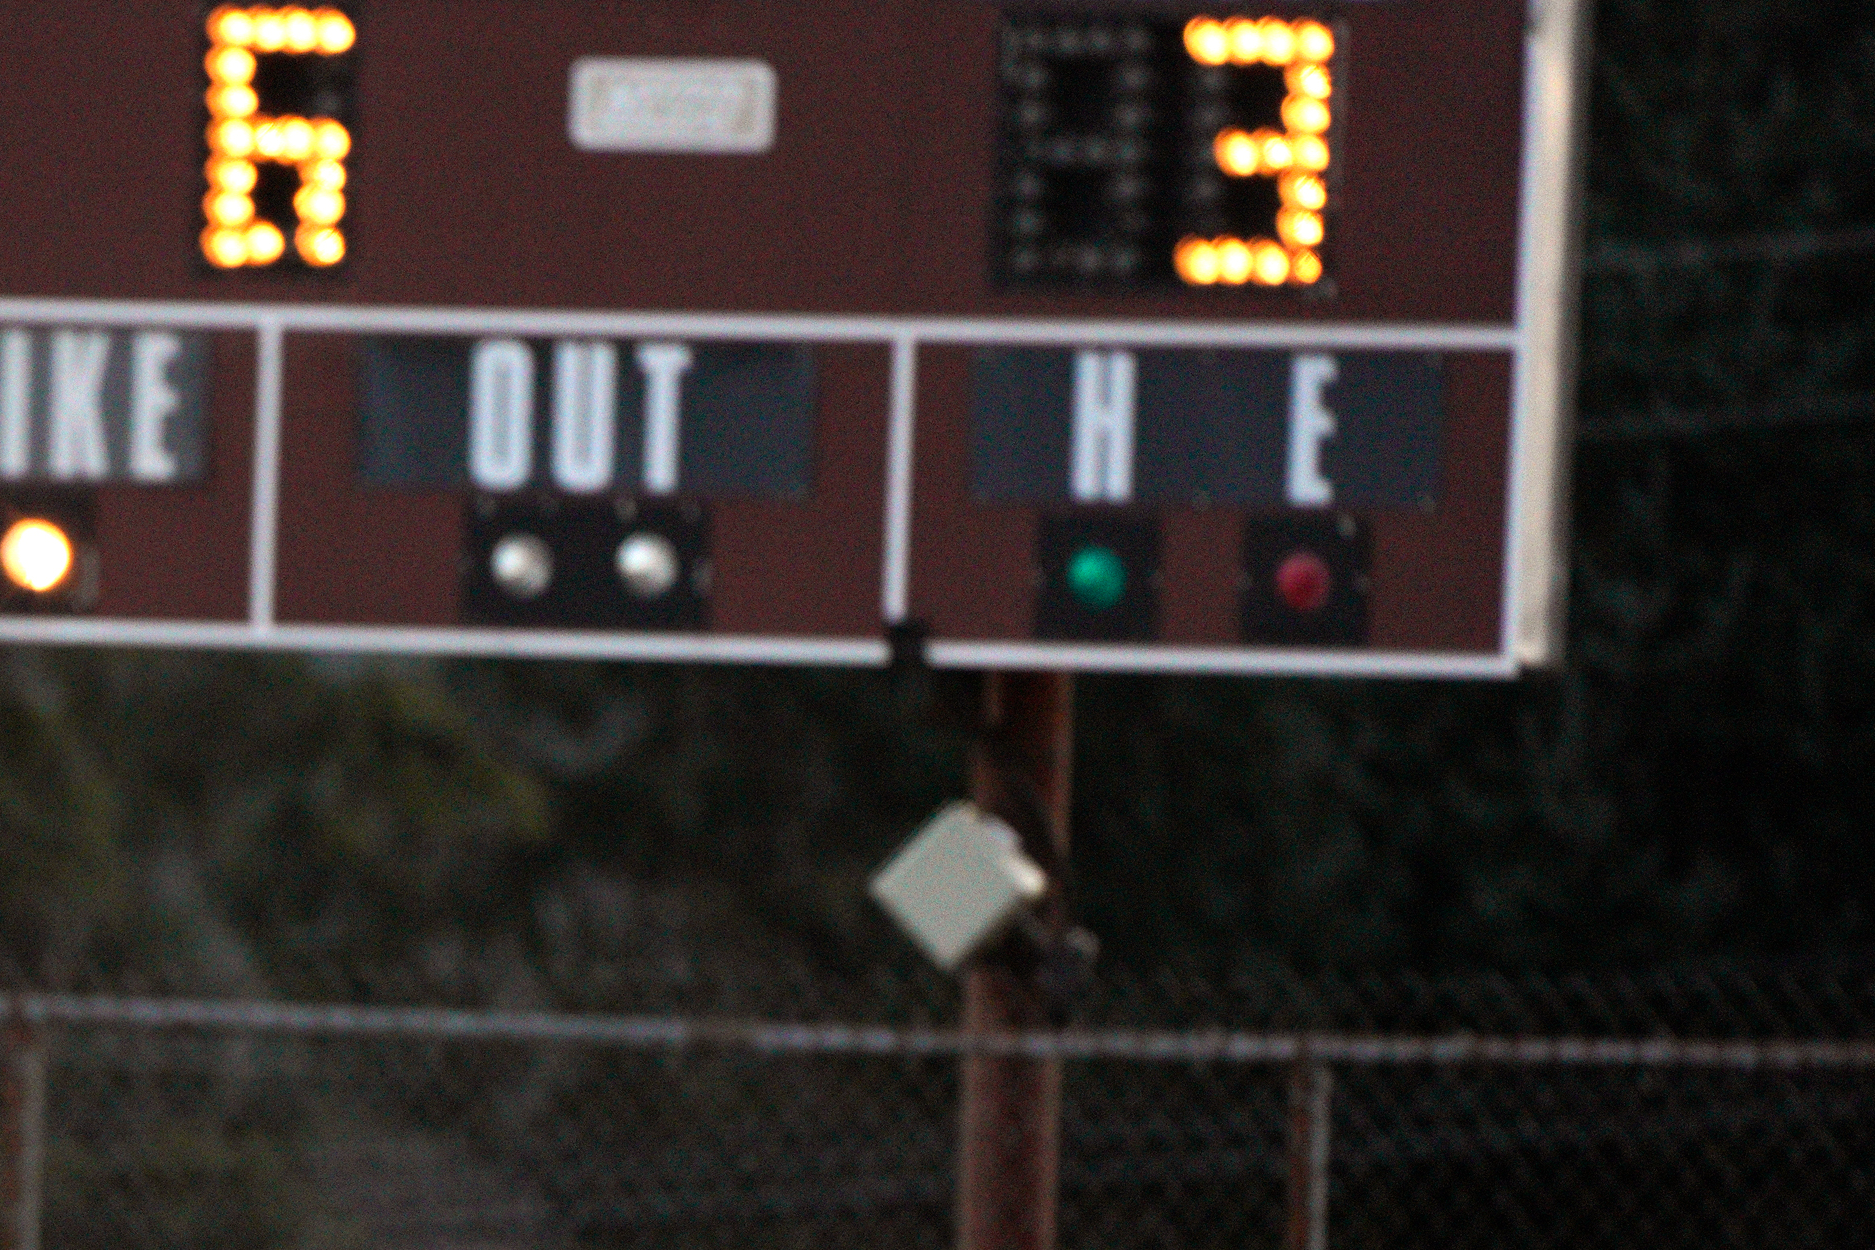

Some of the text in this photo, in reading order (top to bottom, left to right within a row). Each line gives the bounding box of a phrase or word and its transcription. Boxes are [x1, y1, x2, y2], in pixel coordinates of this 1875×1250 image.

[202, 5, 355, 268] 6
[1173, 14, 1333, 285] 3
[467, 340, 693, 496] OUT
[1070, 350, 1338, 506] H E
